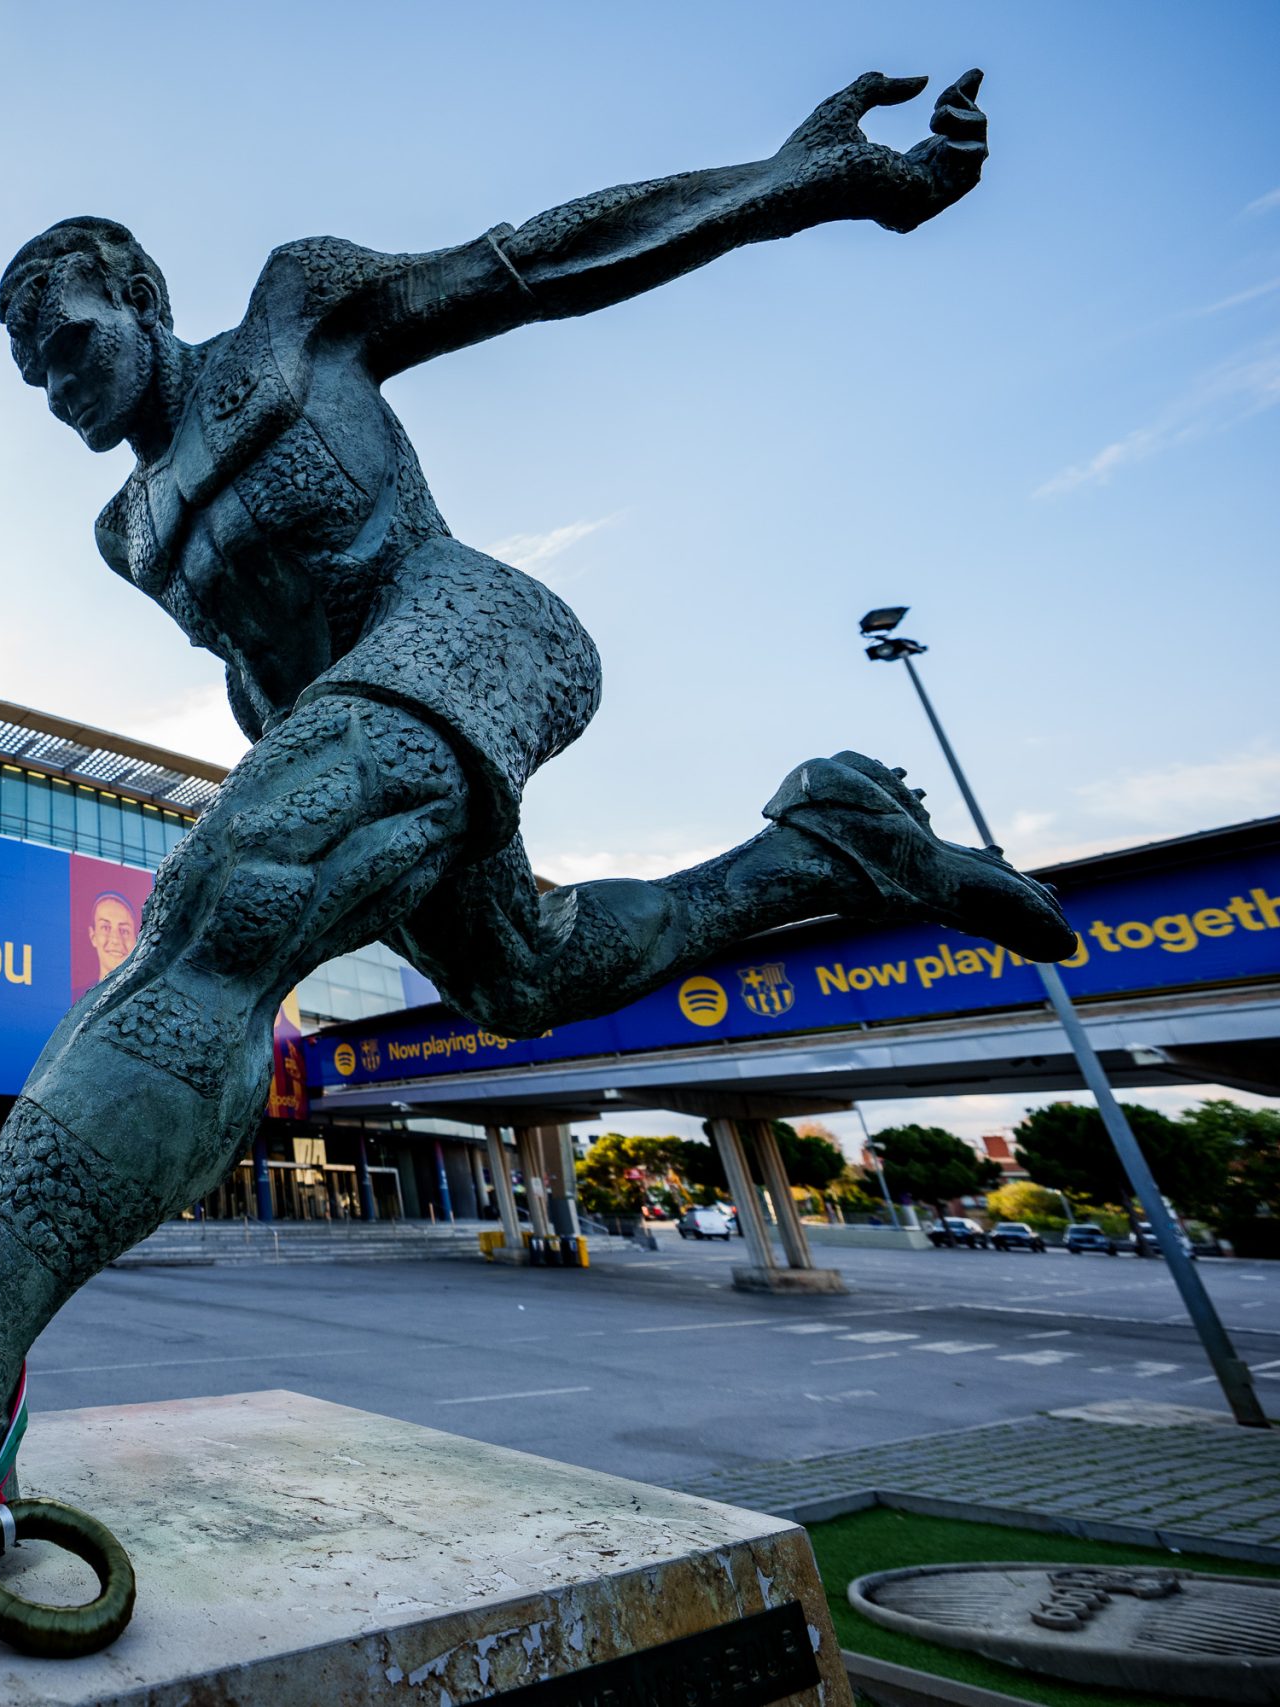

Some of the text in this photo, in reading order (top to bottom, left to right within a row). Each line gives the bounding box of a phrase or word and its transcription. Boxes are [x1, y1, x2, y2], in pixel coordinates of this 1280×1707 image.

[815, 961, 907, 996] Now
[914, 931, 1090, 988] playg
[387, 1042, 421, 1061] Now
[422, 1032, 477, 1060] playing
